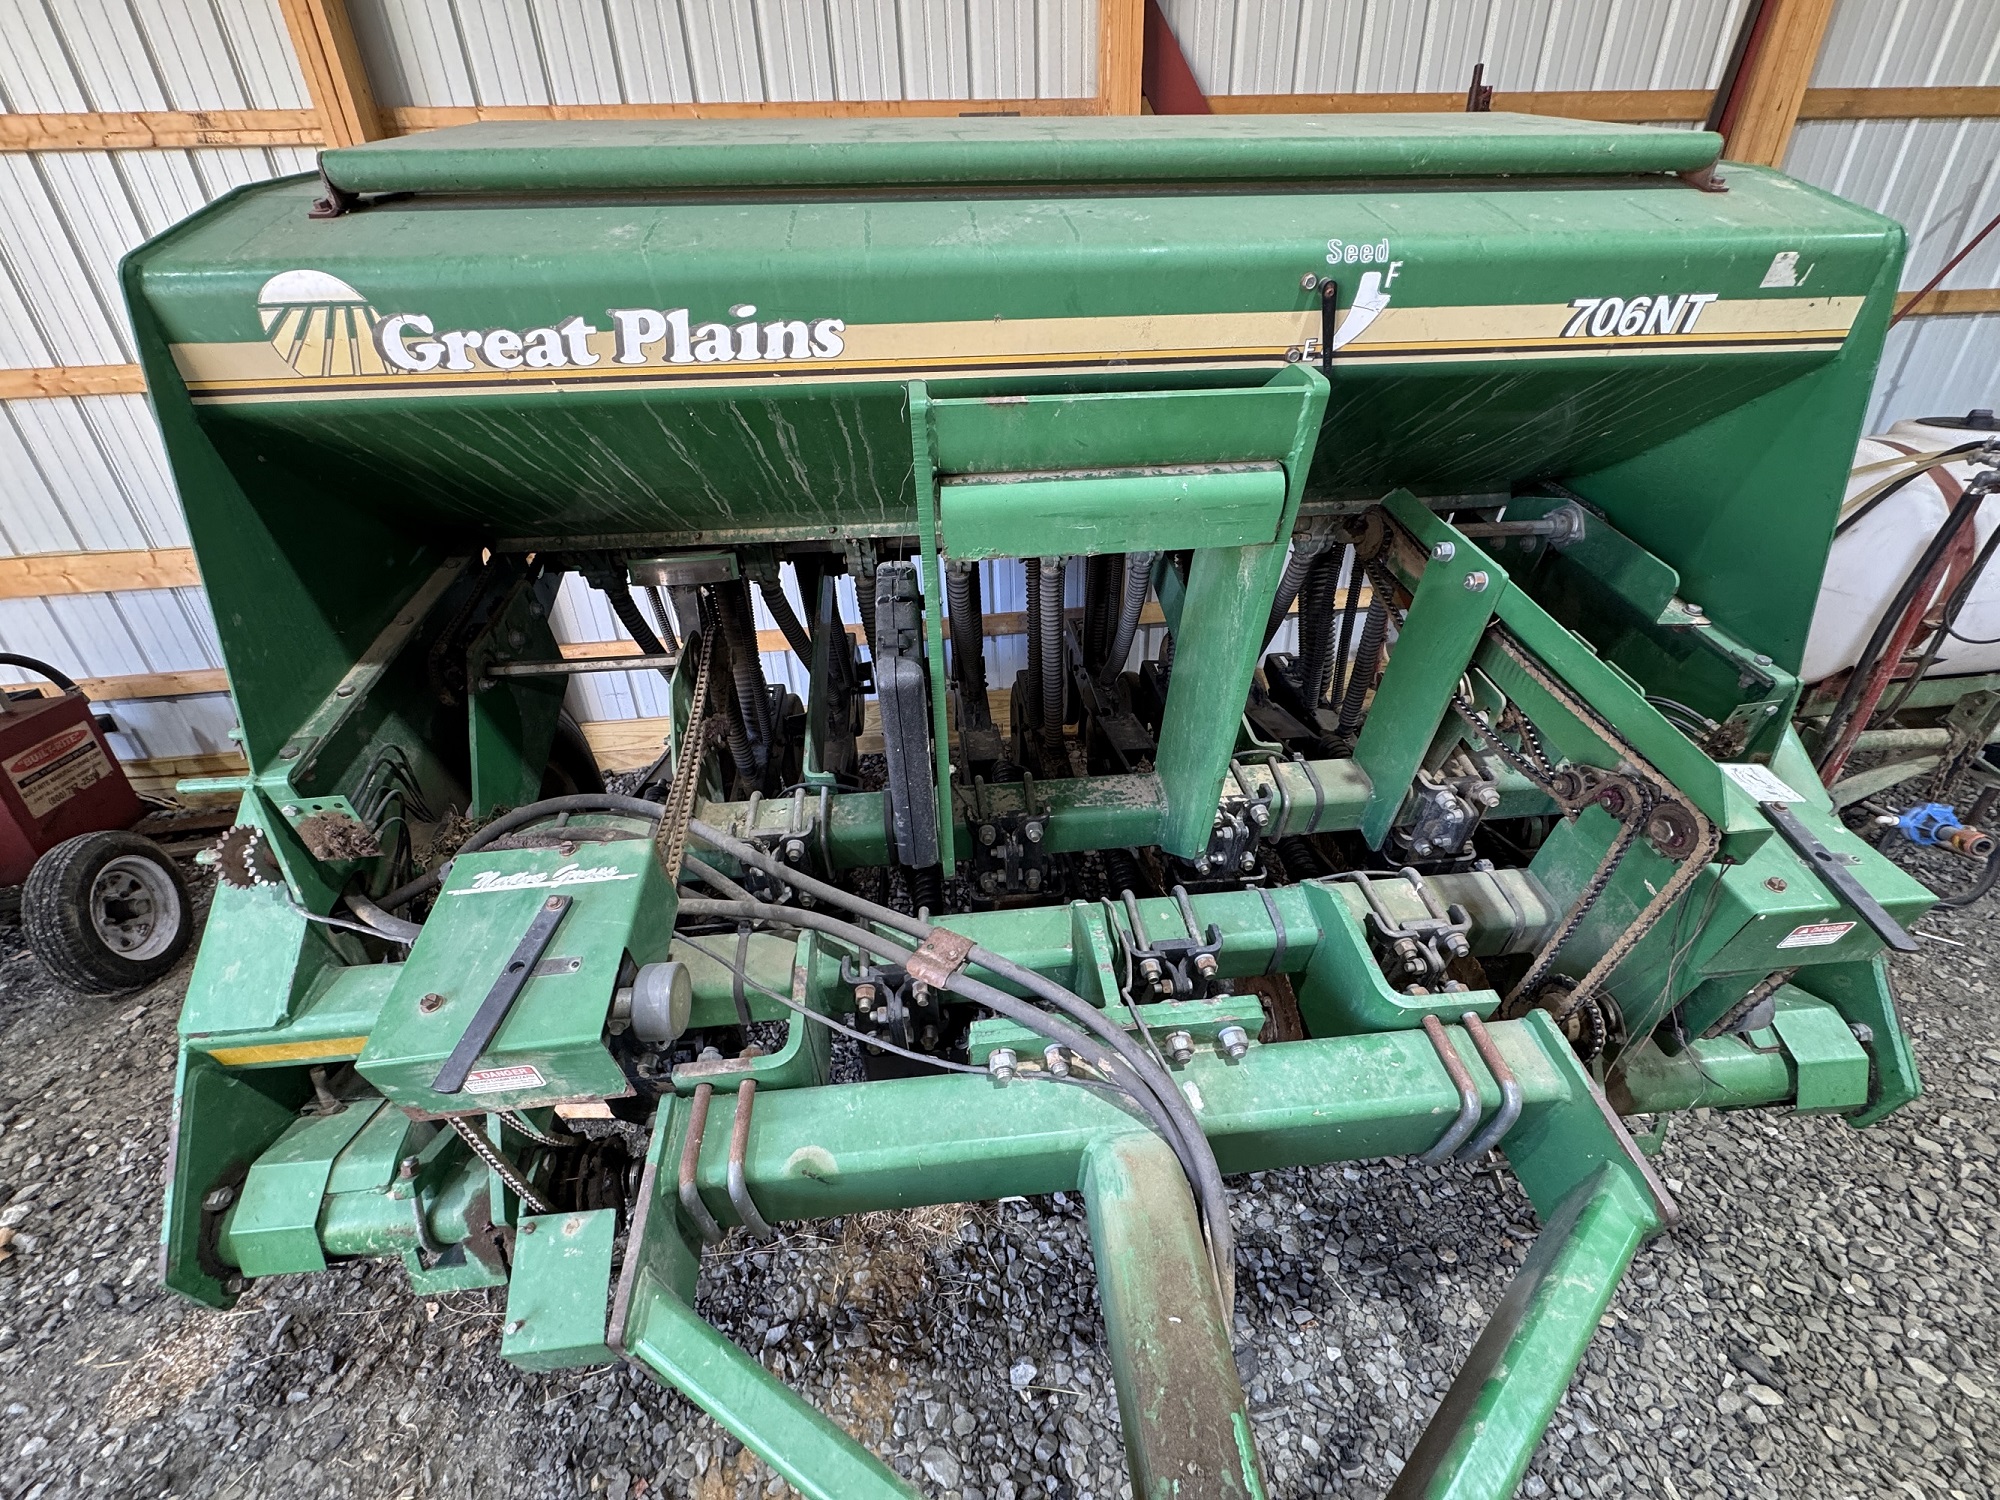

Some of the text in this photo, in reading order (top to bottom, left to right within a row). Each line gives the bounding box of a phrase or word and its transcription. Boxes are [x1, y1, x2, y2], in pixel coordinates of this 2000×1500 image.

[1326, 238, 1389, 264] Seed
[1384, 261, 1403, 288] F
[1559, 292, 1719, 338] 706NT
[375, 303, 847, 374] Great Plains
[1301, 337, 1318, 361] E
[481, 1068, 528, 1080] DANGER
